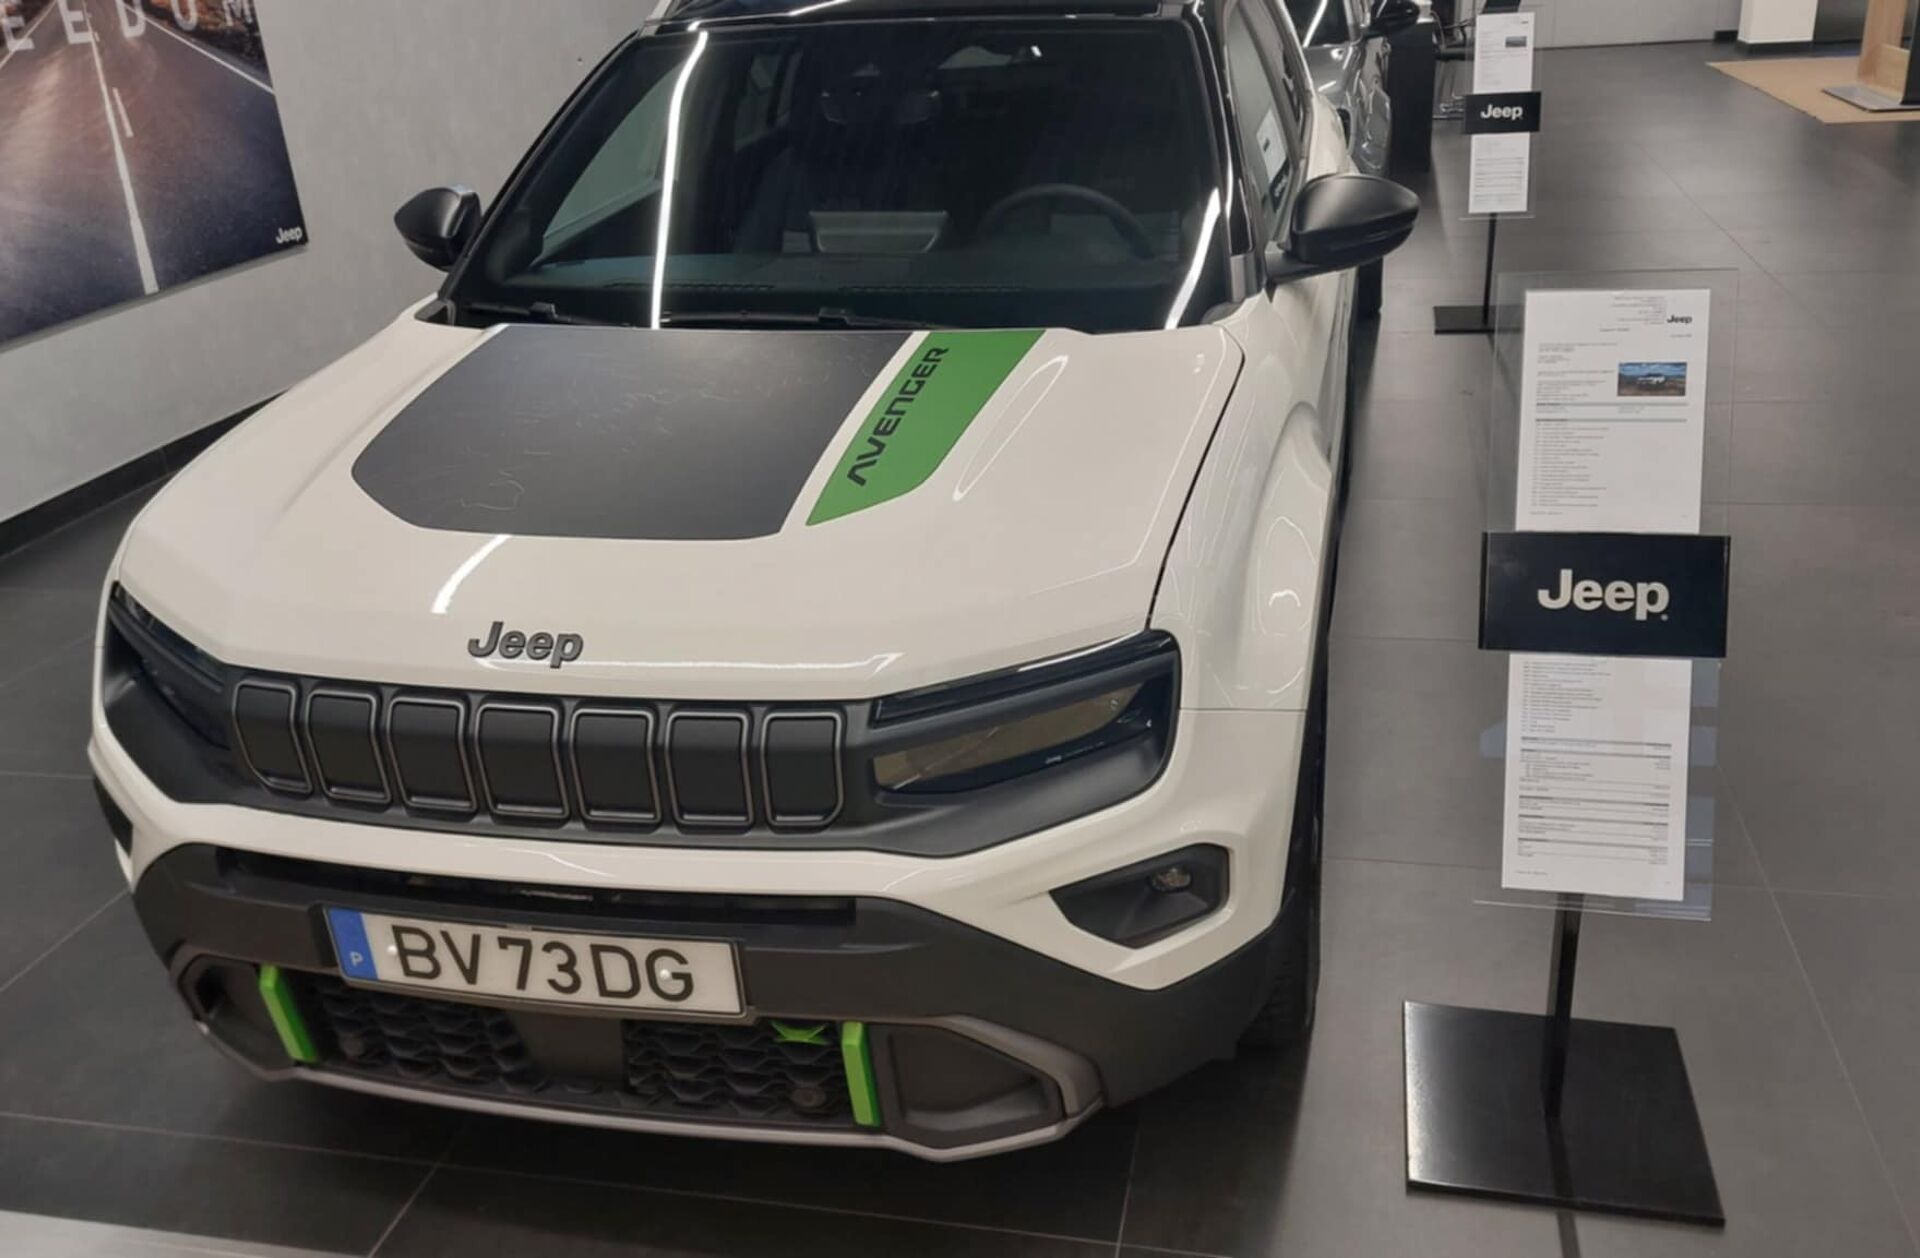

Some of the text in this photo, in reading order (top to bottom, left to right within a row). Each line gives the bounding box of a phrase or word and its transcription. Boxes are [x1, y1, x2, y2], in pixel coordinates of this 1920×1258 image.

[1480, 104, 1523, 120] Jeep
[275, 227, 302, 244] Jeep
[1666, 314, 1693, 324] Jeep
[847, 347, 949, 486] AVENGER
[1537, 568, 1670, 621] Jeep
[467, 621, 584, 669] Jeep
[350, 951, 363, 967] P
